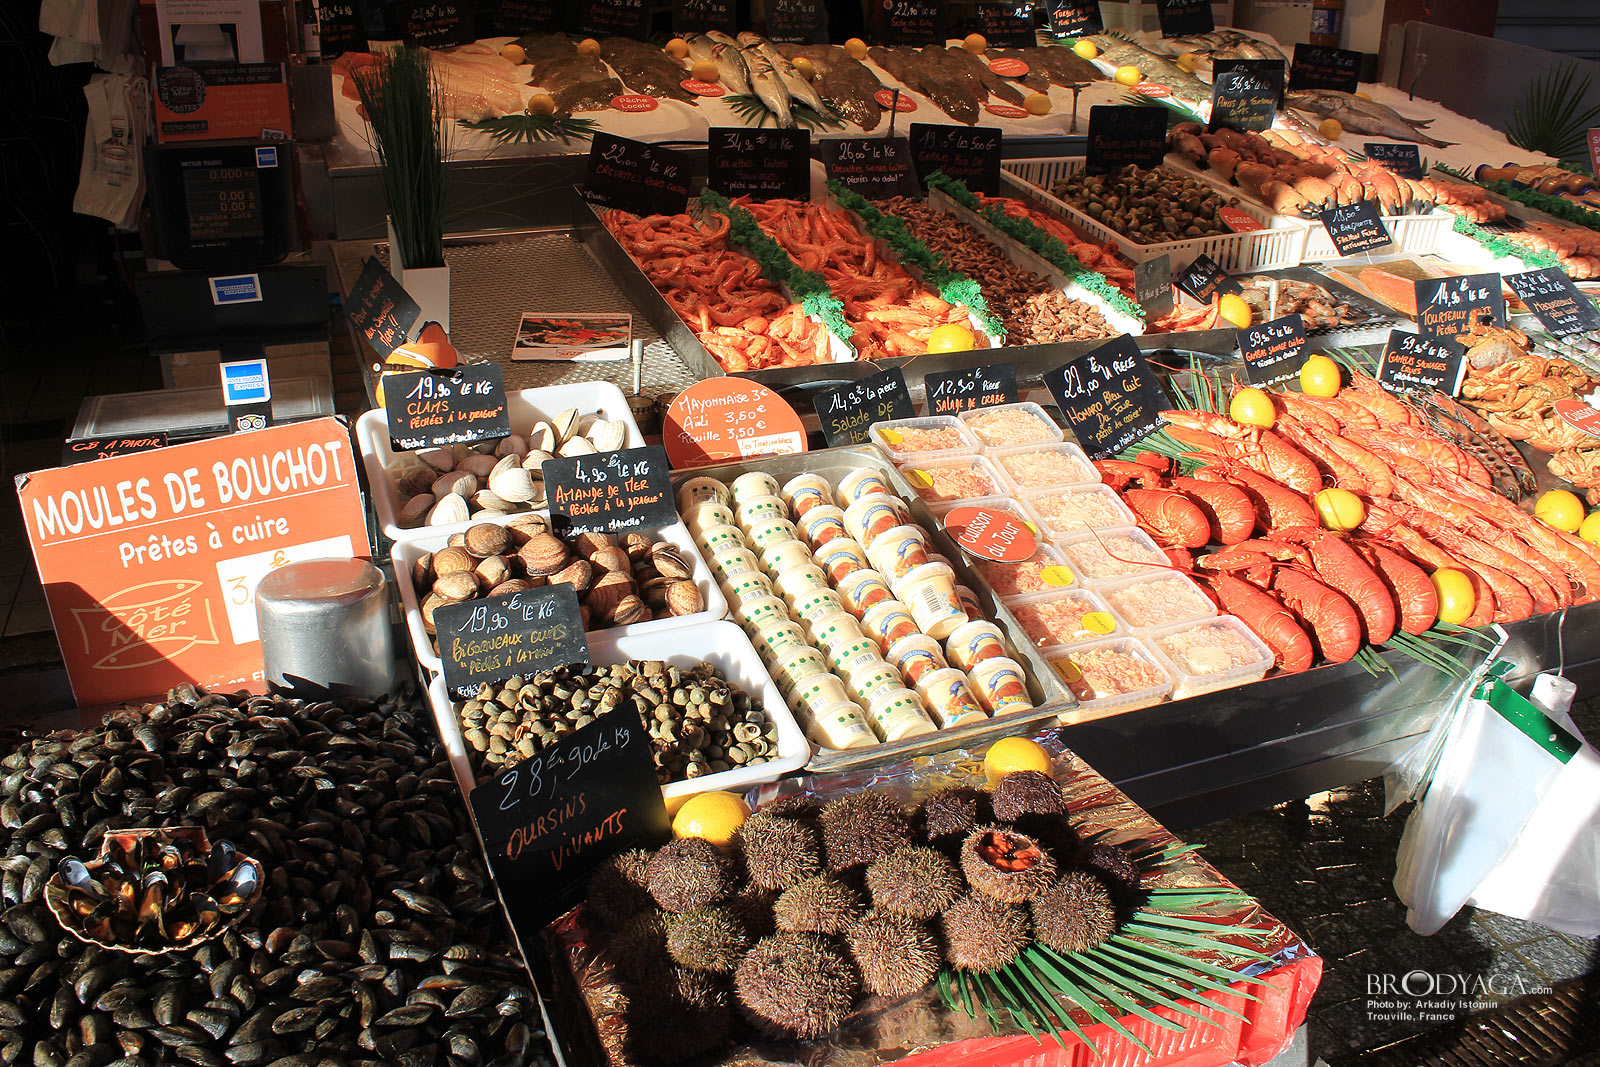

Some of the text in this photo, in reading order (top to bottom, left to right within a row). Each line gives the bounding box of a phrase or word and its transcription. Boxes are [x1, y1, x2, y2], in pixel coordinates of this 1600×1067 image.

[621, 102, 651, 110] Locale
[884, 144, 896, 158] KG
[209, 168, 242, 180] 0.000
[663, 164, 678, 178] KG
[1420, 304, 1467, 326] TOURTEAUX
[227, 375, 262, 384] AMERICAN
[235, 382, 265, 391] EXPRESS
[460, 382, 473, 396] LE
[475, 379, 494, 395] KG
[406, 400, 450, 417] CLAMS
[967, 398, 976, 410] DE
[981, 393, 1006, 405] CRABE
[1066, 402, 1103, 426] HOMARD
[1102, 390, 1125, 407] Bleu
[457, 411, 467, 421] LA
[831, 400, 894, 435] Salade DE
[118, 435, 163, 449] PARTIR
[678, 430, 721, 444] Rouille
[617, 463, 631, 478] LE
[633, 460, 651, 478] KG
[32, 439, 343, 541] MOULES DE BOUCHOT
[555, 476, 649, 504] AMANDE DE MER
[615, 498, 625, 508] LA
[958, 510, 995, 544] Cuisson
[119, 514, 290, 570] Prêtes à cuire
[983, 521, 1021, 558] du Jour
[100, 595, 193, 635] Côté
[522, 606, 535, 622] LE
[538, 600, 556, 620] KG
[110, 616, 188, 649] Mer
[452, 623, 567, 663] BIGORNEAUX CUITS
[516, 650, 529, 664] LA
[506, 792, 587, 862] OURSINS
[551, 808, 628, 872] VIVANTS
